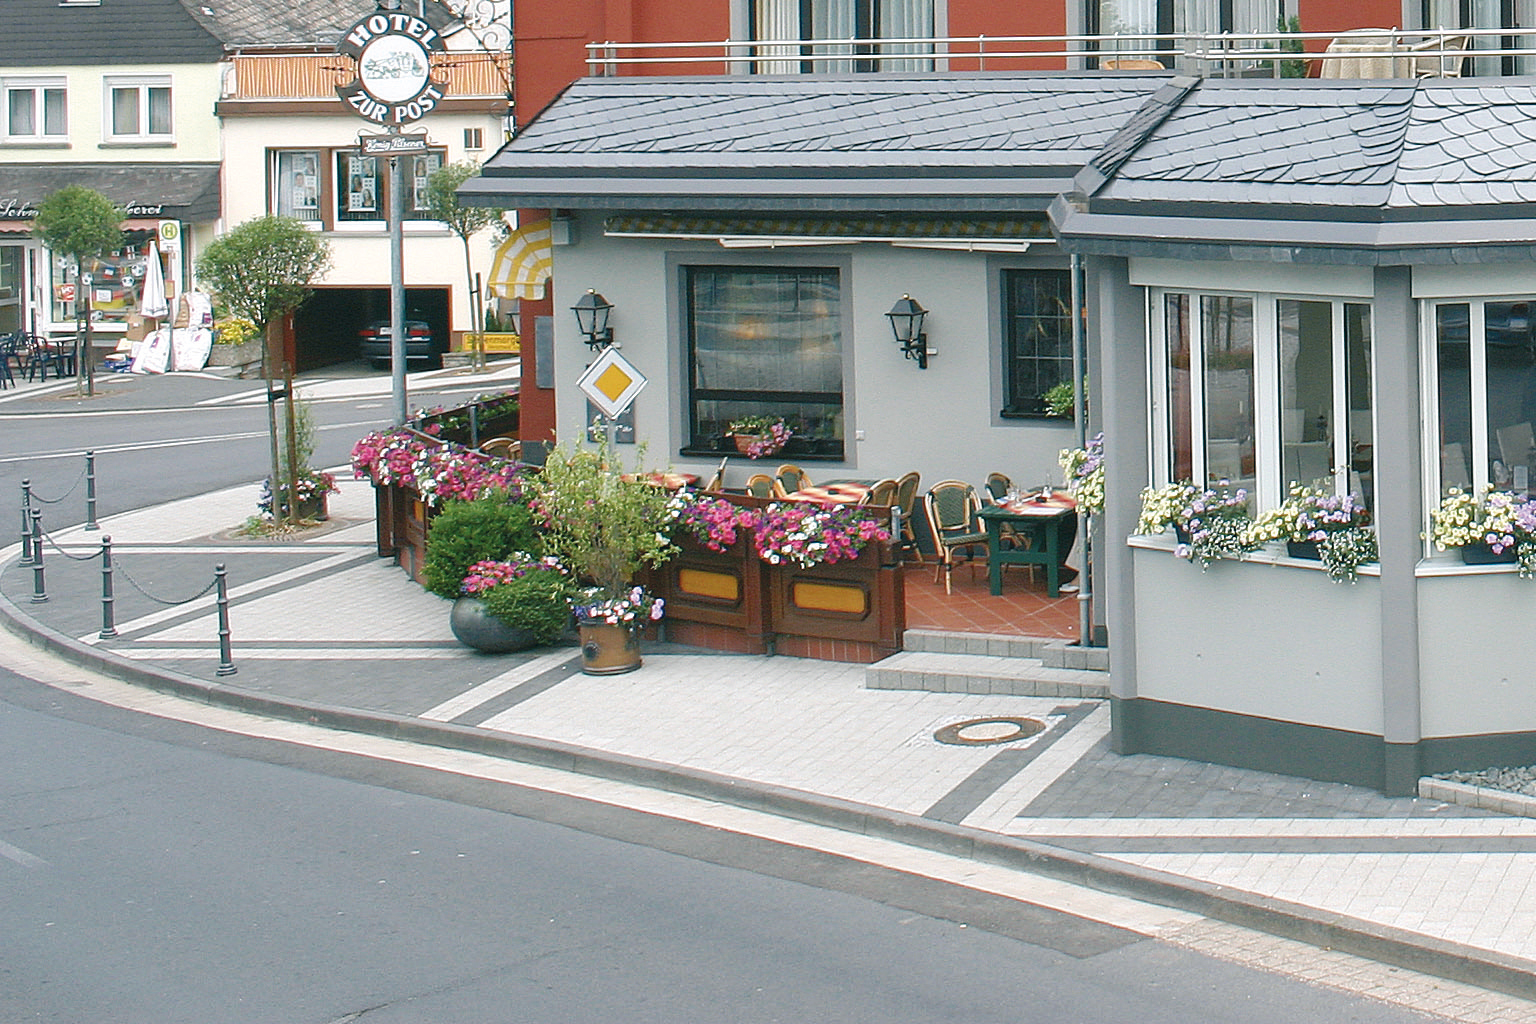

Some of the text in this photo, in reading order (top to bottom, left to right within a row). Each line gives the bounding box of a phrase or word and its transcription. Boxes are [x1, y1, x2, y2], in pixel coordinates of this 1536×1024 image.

[347, 13, 438, 50] HOTEL
[347, 85, 443, 123] ZUR POST
[165, 226, 174, 236] H
